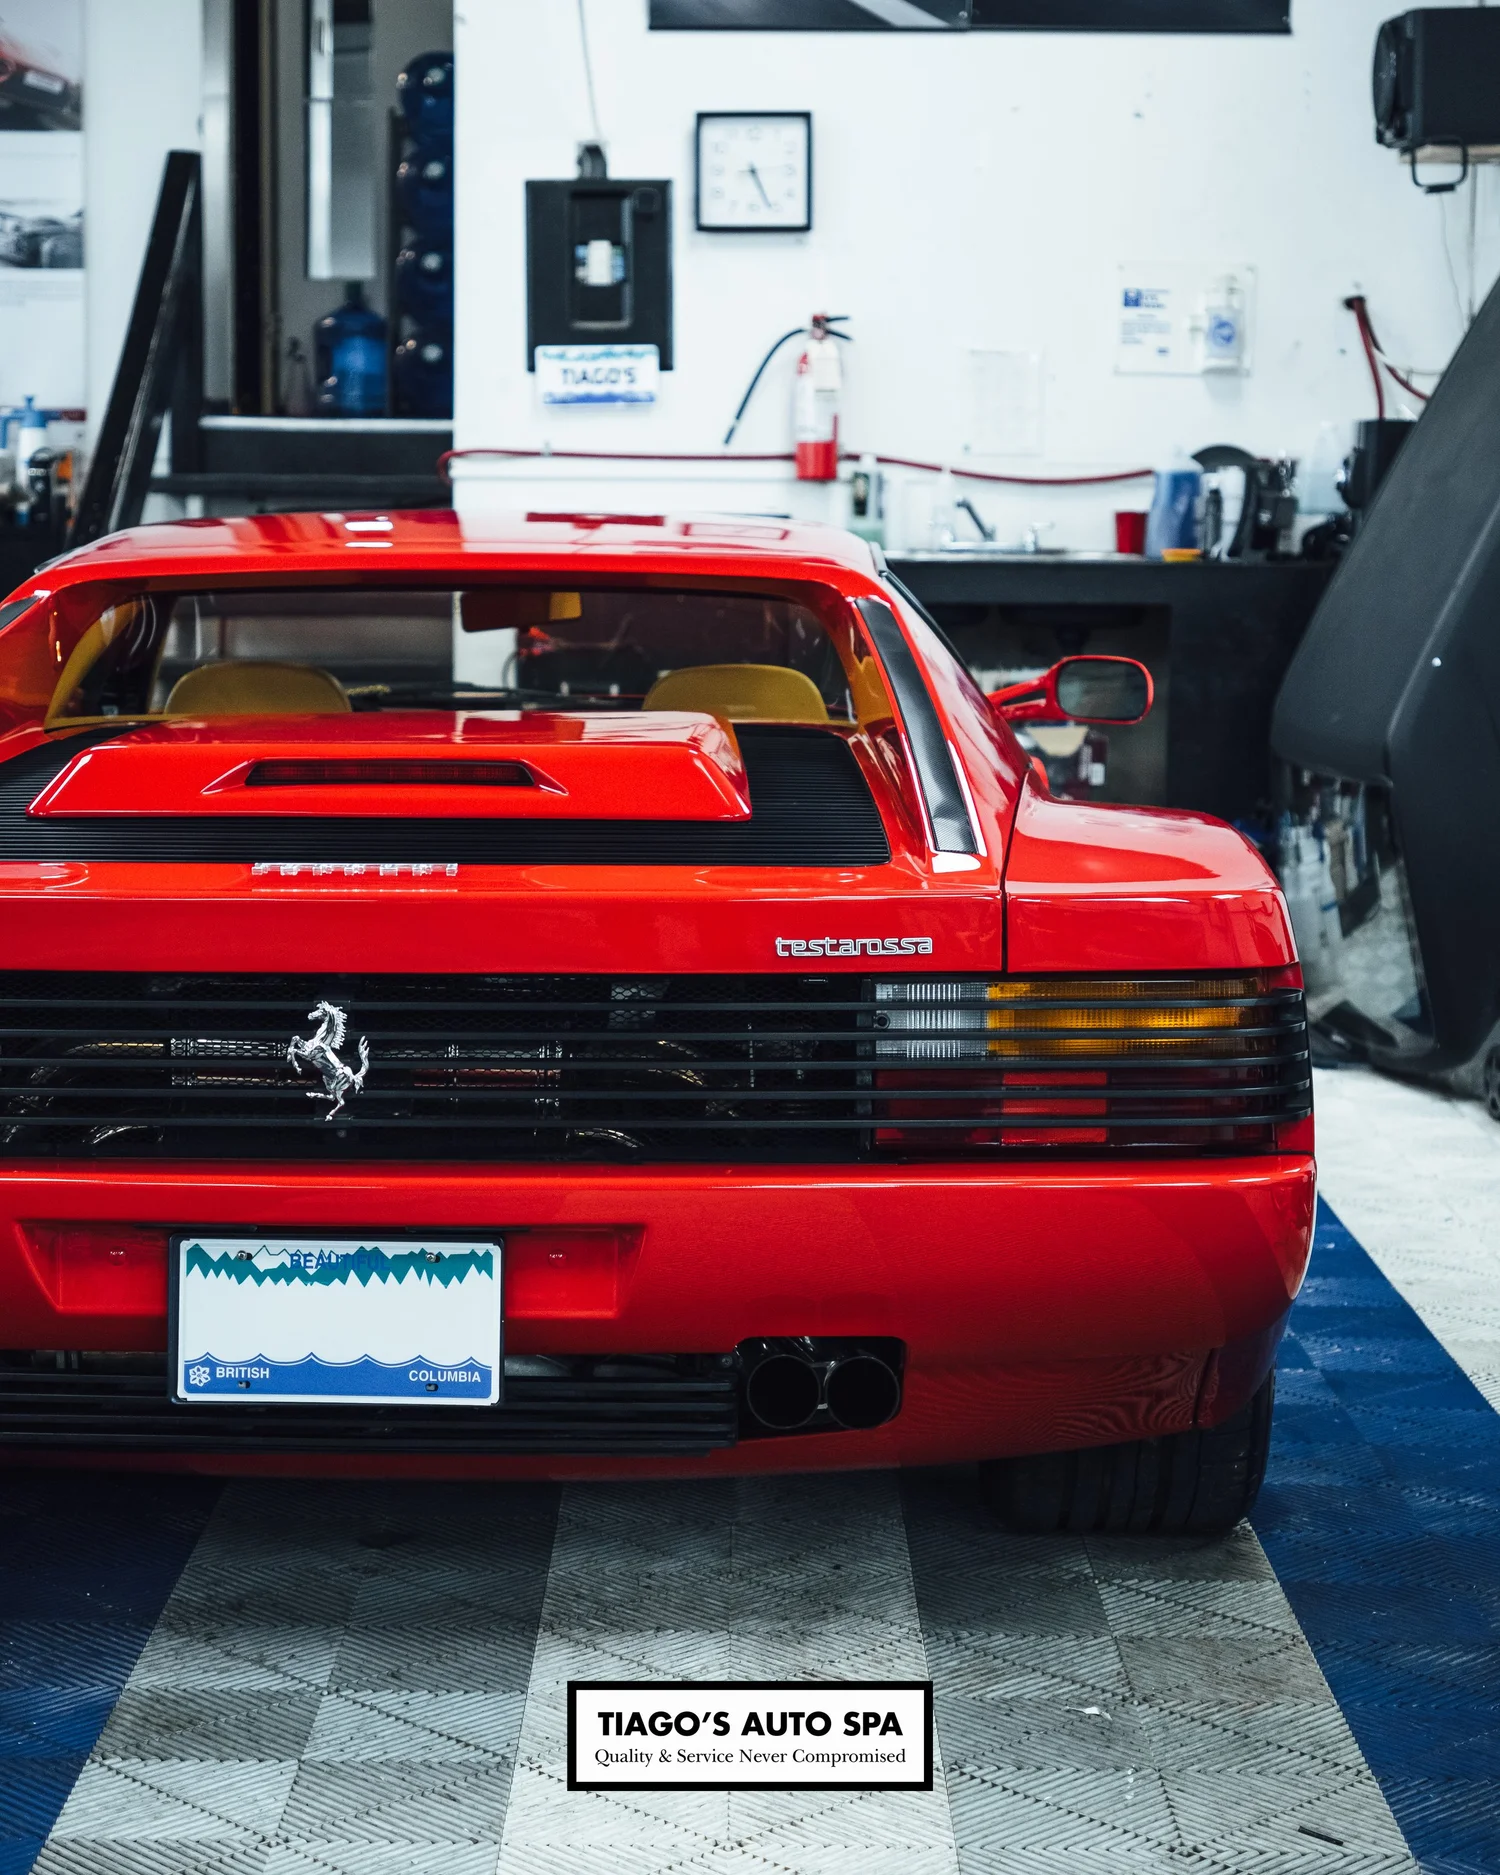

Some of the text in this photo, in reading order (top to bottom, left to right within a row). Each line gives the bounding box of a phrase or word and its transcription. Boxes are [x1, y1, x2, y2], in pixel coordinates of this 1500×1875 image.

[560, 367, 637, 385] TIAGO'S
[775, 936, 933, 957] testarossa
[289, 1252, 391, 1270] BEAUTIFUL
[216, 1366, 481, 1383] BRITISH COLUMBIA
